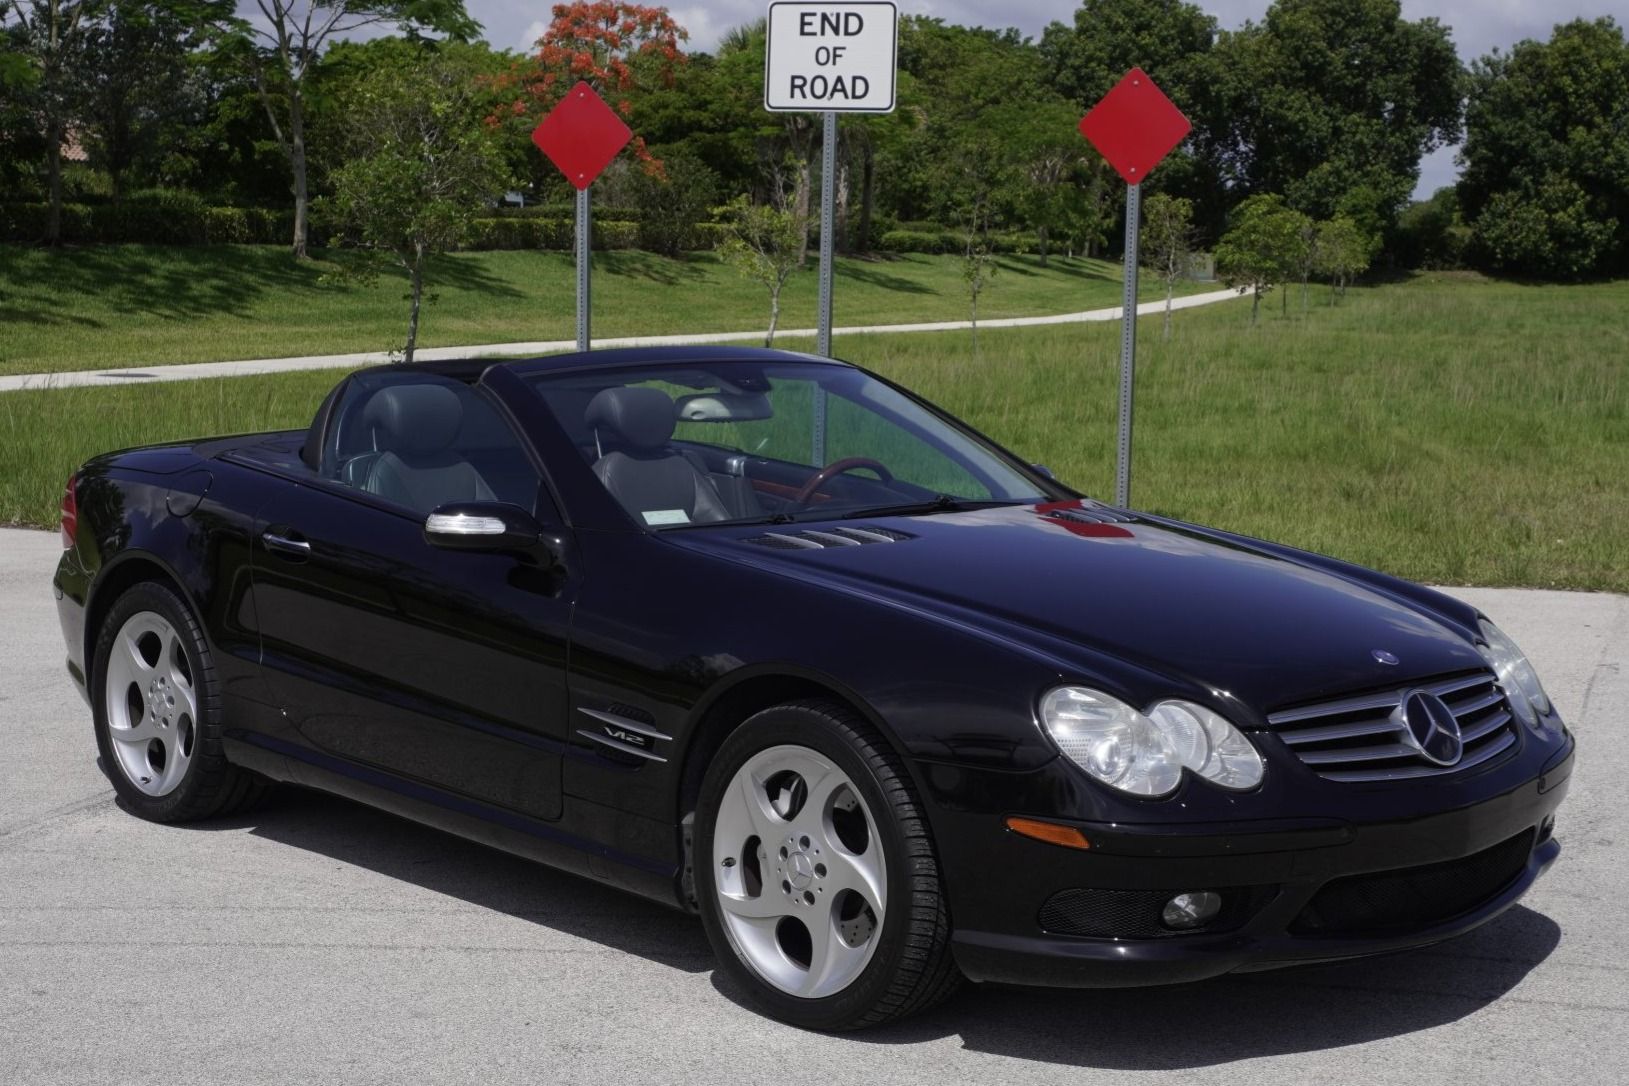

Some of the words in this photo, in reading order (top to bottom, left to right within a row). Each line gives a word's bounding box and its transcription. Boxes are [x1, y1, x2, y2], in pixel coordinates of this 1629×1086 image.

[800, 12, 864, 36] END
[815, 46, 847, 66] OF
[790, 75, 869, 100] ROAD
[604, 726, 645, 746] V12
